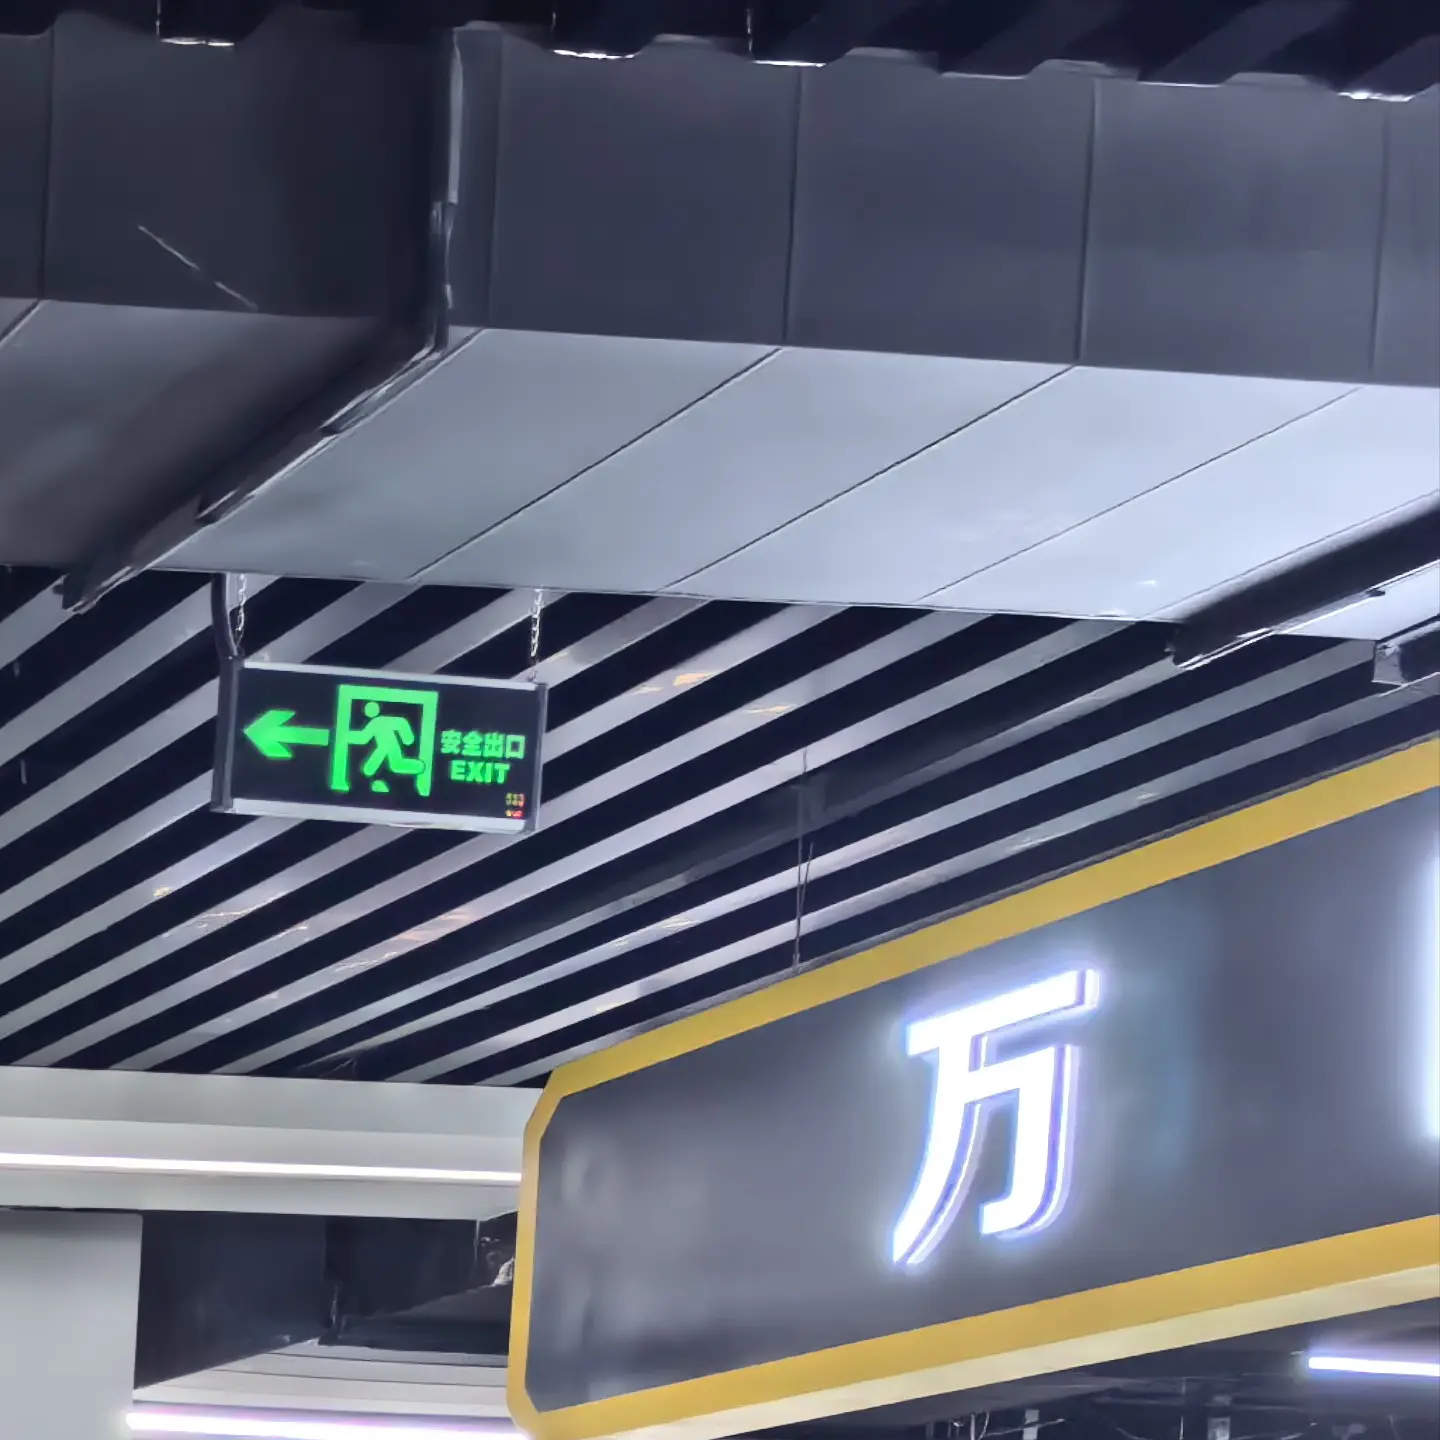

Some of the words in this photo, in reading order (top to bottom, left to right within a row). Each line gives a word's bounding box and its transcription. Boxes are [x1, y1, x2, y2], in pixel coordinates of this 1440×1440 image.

[441, 729, 526, 759] 安全出口
[450, 760, 510, 785] EXIT
